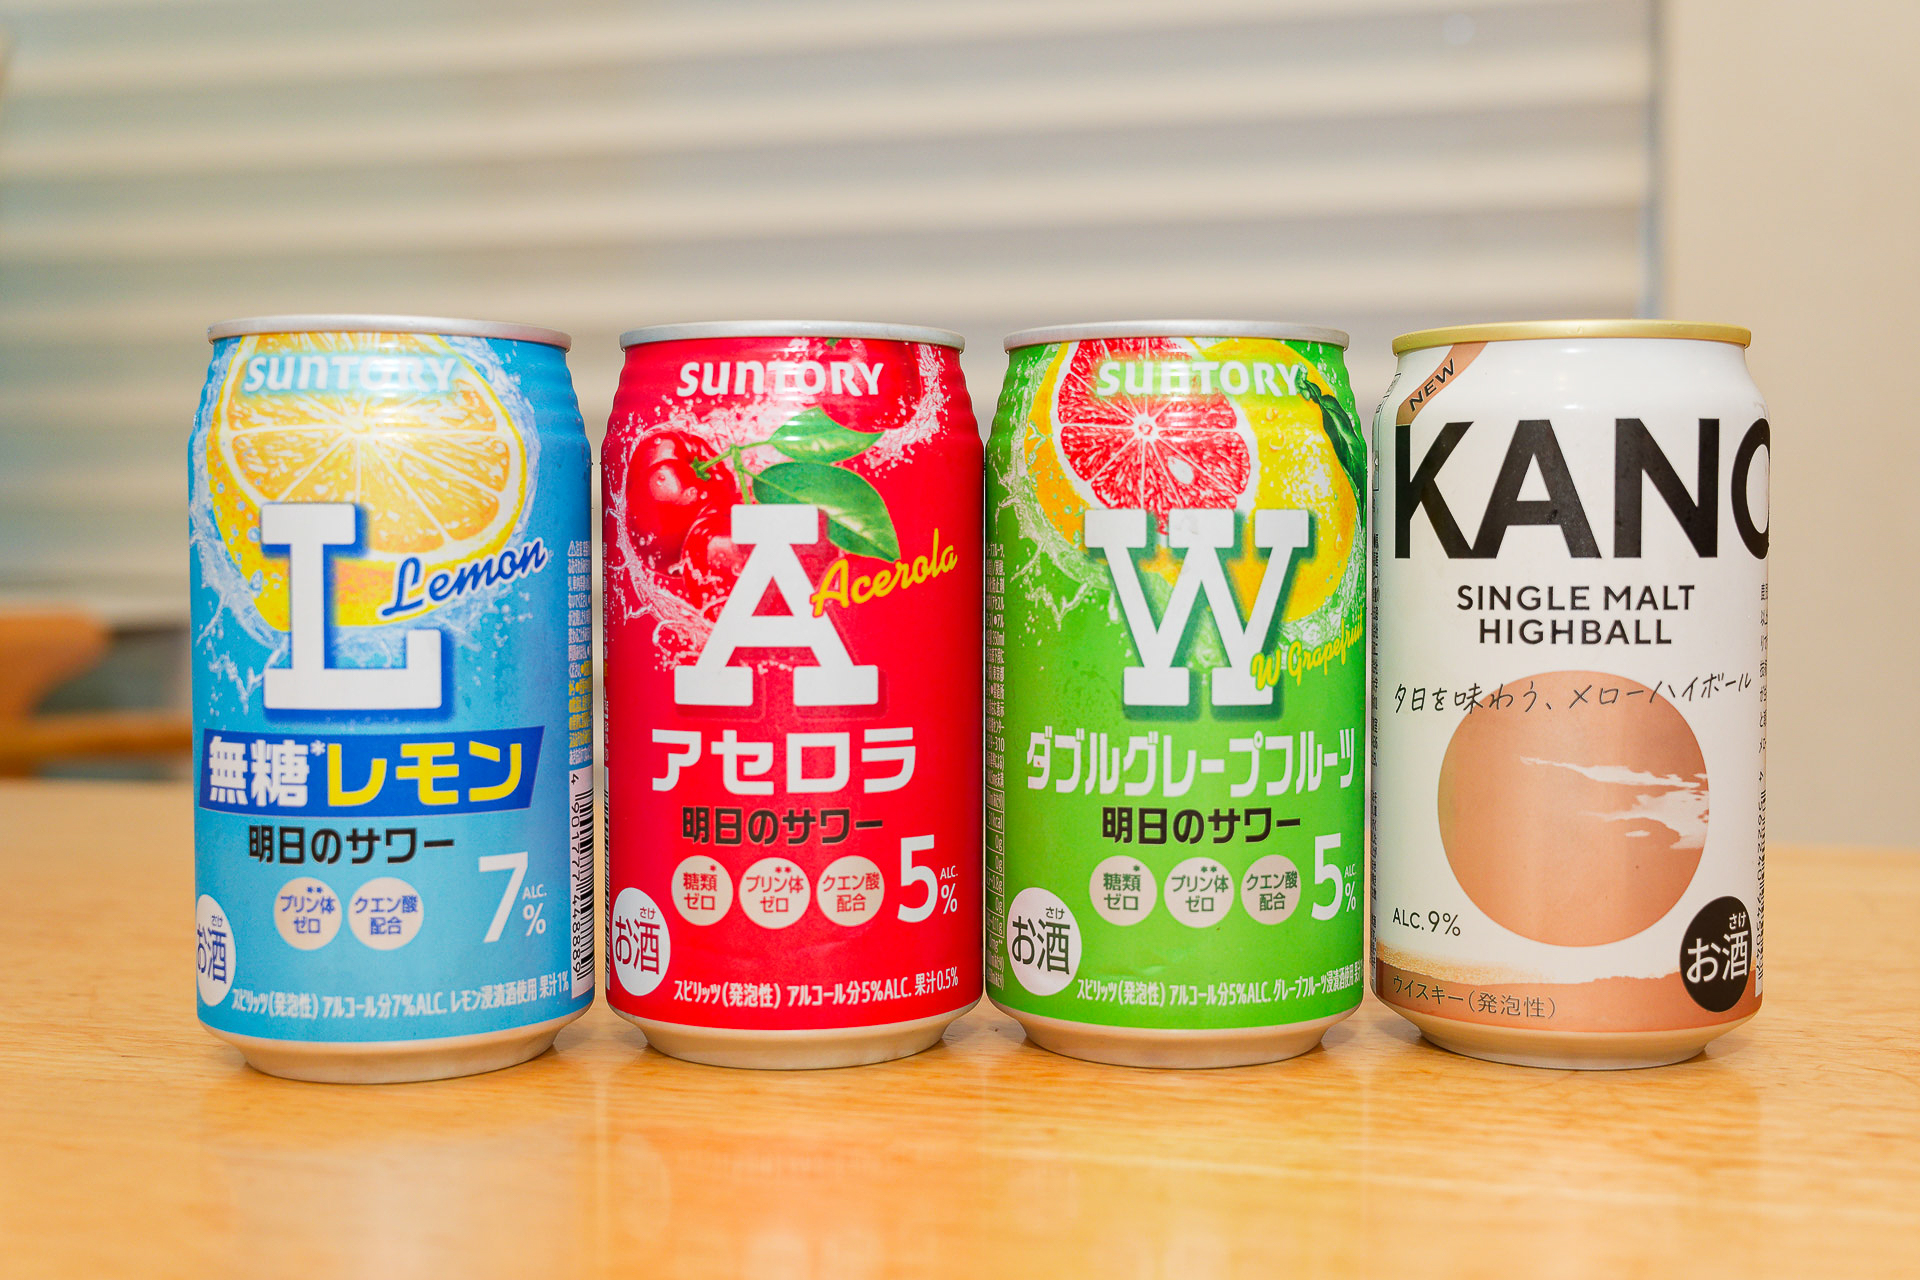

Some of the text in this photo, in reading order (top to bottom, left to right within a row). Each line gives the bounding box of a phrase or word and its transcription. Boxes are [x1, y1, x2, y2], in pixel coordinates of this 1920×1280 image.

[244, 355, 456, 393] SUNTORY
[676, 361, 885, 398] SUNTORY
[1096, 360, 1304, 397] SUNTORY
[1407, 358, 1456, 412] NEW
[1394, 416, 1770, 560] KANO
[381, 541, 547, 616] Lemon
[811, 527, 958, 617] Acerola
[260, 502, 443, 710] L
[674, 503, 879, 706] A
[1084, 508, 1309, 706] W
[1456, 583, 1695, 611] SINGLE MALT
[1479, 618, 1673, 646] HIGHBALL
[1250, 648, 1281, 691] W
[651, 725, 917, 796] アセロラ
[1026, 724, 1355, 799] ダブルグレープフルーツ
[681, 805, 884, 846] 明日のサワー
[1102, 806, 1301, 846] 明日のサワー
[248, 824, 455, 865] 明日のサワー
[683, 872, 718, 892] 糖類
[745, 875, 805, 894] プリン体
[822, 872, 881, 891] クエン酸
[940, 866, 959, 880] ALC.
[1103, 872, 1141, 892] 糖類
[1171, 874, 1229, 894] プリン体
[1246, 871, 1298, 890] クエン酸
[354, 895, 419, 914] クエン酸
[521, 885, 548, 898] ALC.
[684, 892, 716, 912] ゼロ
[760, 896, 790, 914] ゼロ
[836, 894, 867, 913] 配合
[1104, 893, 1139, 912] ゼロ
[1185, 896, 1215, 914] ゼロ
[1259, 893, 1287, 912] 配合
[369, 916, 403, 936] 配合
[639, 906, 657, 919] さけ
[1045, 906, 1065, 920] さけ
[1392, 908, 1462, 937] ALC. 9%
[1728, 913, 1747, 930] さけ
[293, 918, 321, 936] ゼロ
[614, 914, 661, 976] お酒
[1011, 915, 1071, 976] お酒
[1687, 928, 1750, 984] お酒
